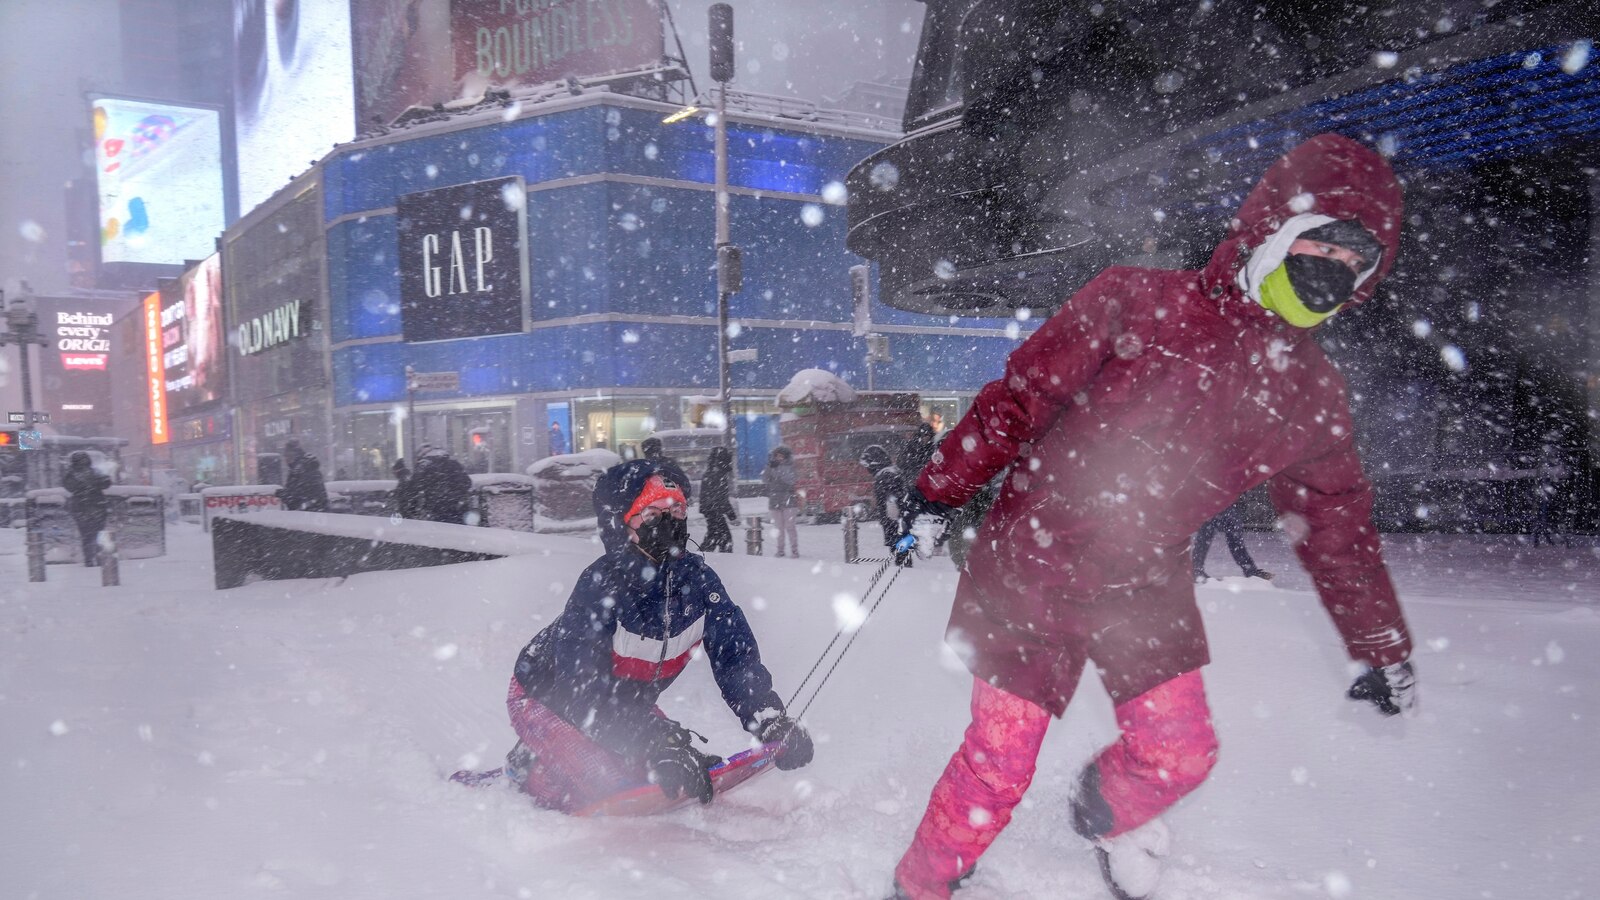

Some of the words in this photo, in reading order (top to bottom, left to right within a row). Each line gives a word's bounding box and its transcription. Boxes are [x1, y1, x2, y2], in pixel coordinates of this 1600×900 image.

[475, 0, 634, 78] BOUNDLESS
[423, 226, 494, 298] GAP
[57, 311, 113, 325] Behind
[57, 326, 101, 340] every
[238, 317, 262, 356] OLD
[262, 299, 300, 348] NAVY
